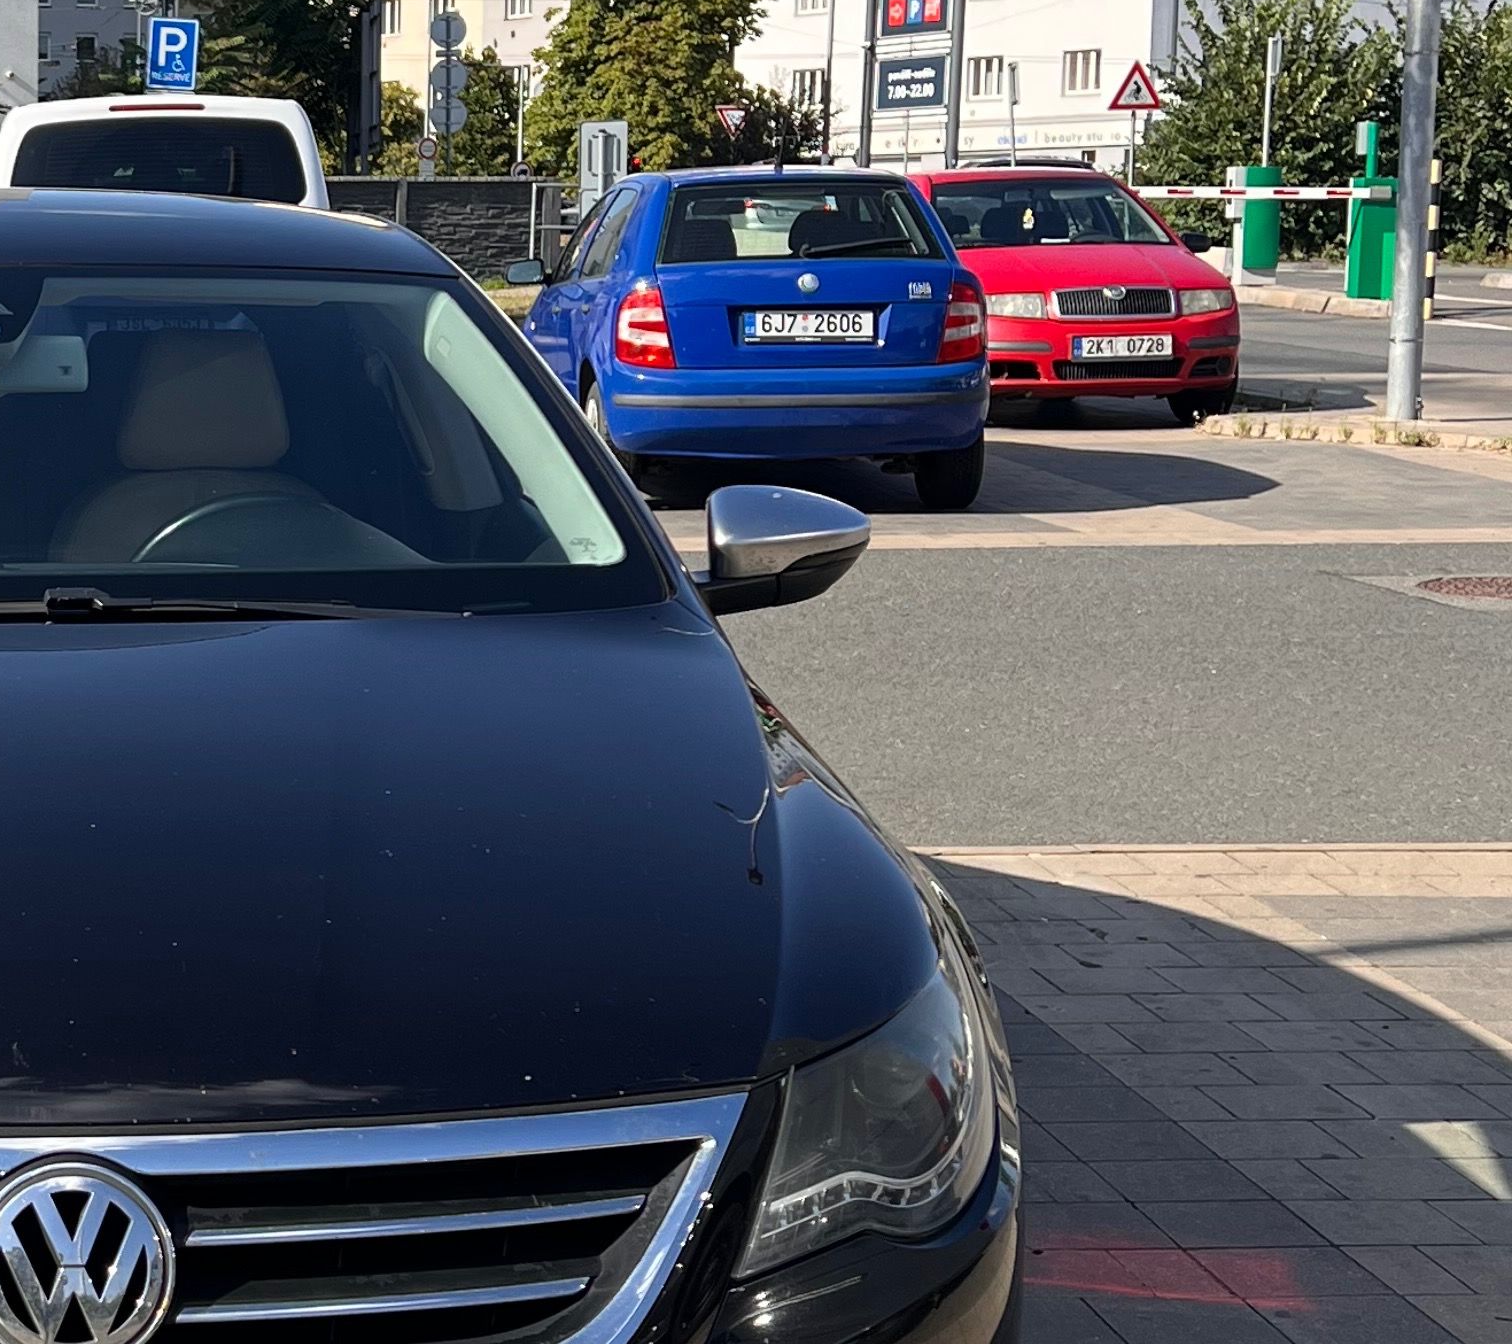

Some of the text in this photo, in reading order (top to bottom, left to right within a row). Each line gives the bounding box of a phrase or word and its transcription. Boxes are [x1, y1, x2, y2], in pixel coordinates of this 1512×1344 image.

[157, 26, 188, 67] P
[761, 313, 863, 333] 6J7 2606
[1086, 339, 1114, 354] 2K1
[1127, 337, 1165, 353] 0728
